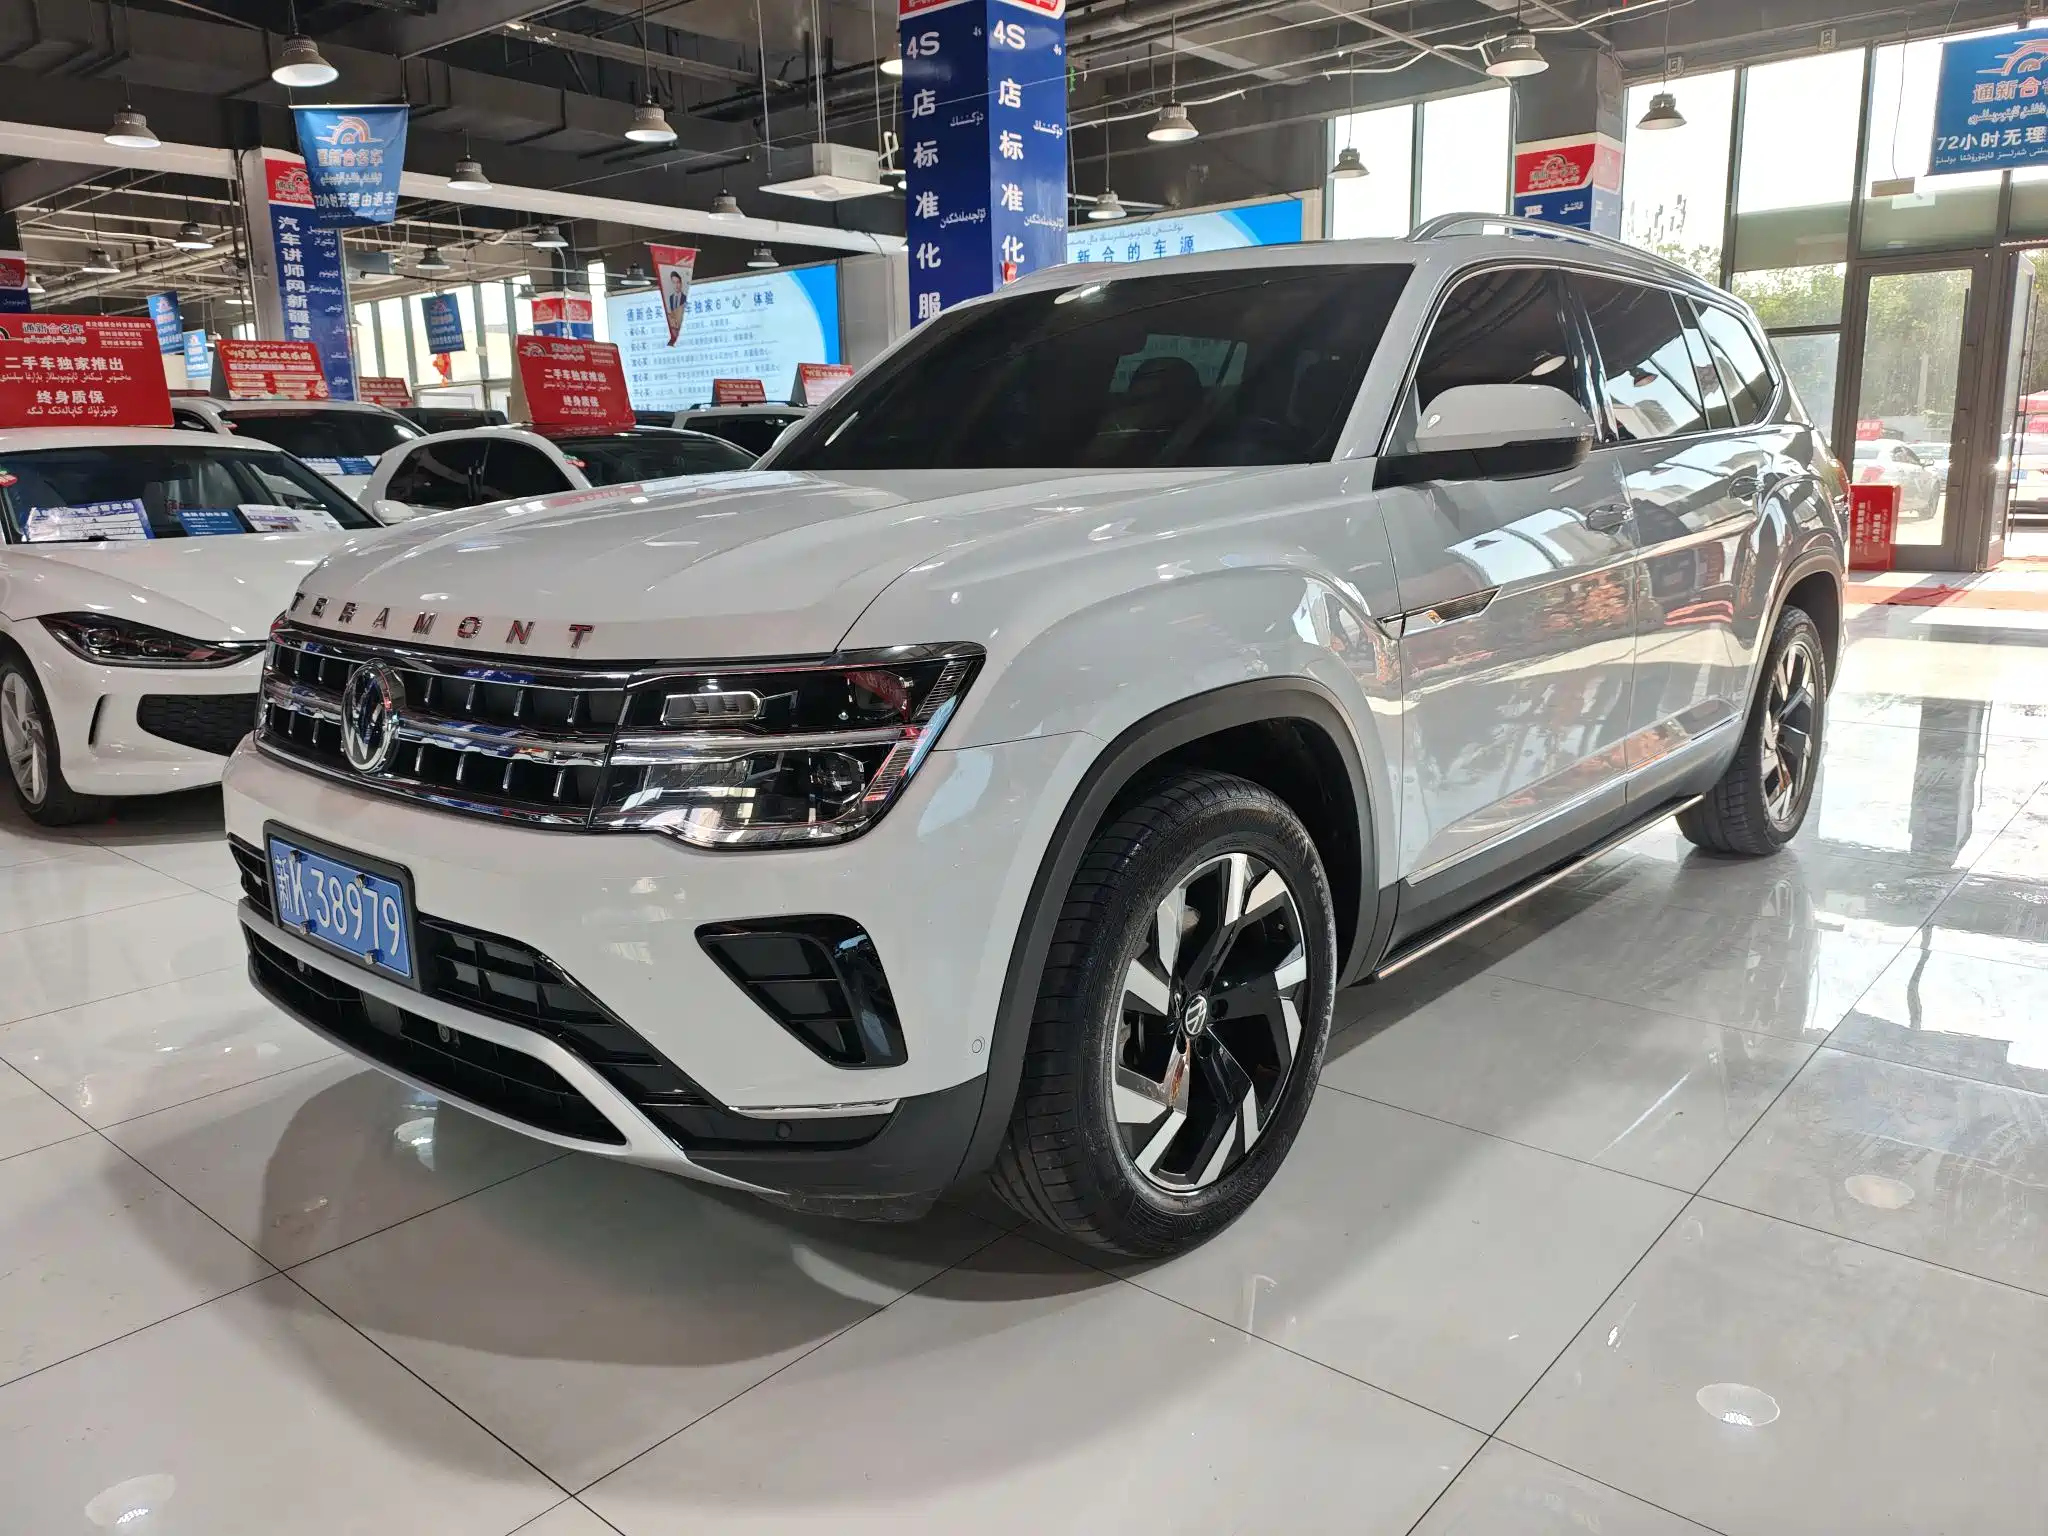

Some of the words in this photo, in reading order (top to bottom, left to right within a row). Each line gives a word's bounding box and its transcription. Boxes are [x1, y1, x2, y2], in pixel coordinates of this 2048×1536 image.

[1936, 126, 2047, 151] 72小时无理
[1077, 235, 1195, 264] 新合的车源
[5, 356, 124, 371] 二手车独家推出
[36, 390, 106, 404] 终身质保
[290, 592, 595, 649] TERAMONT
